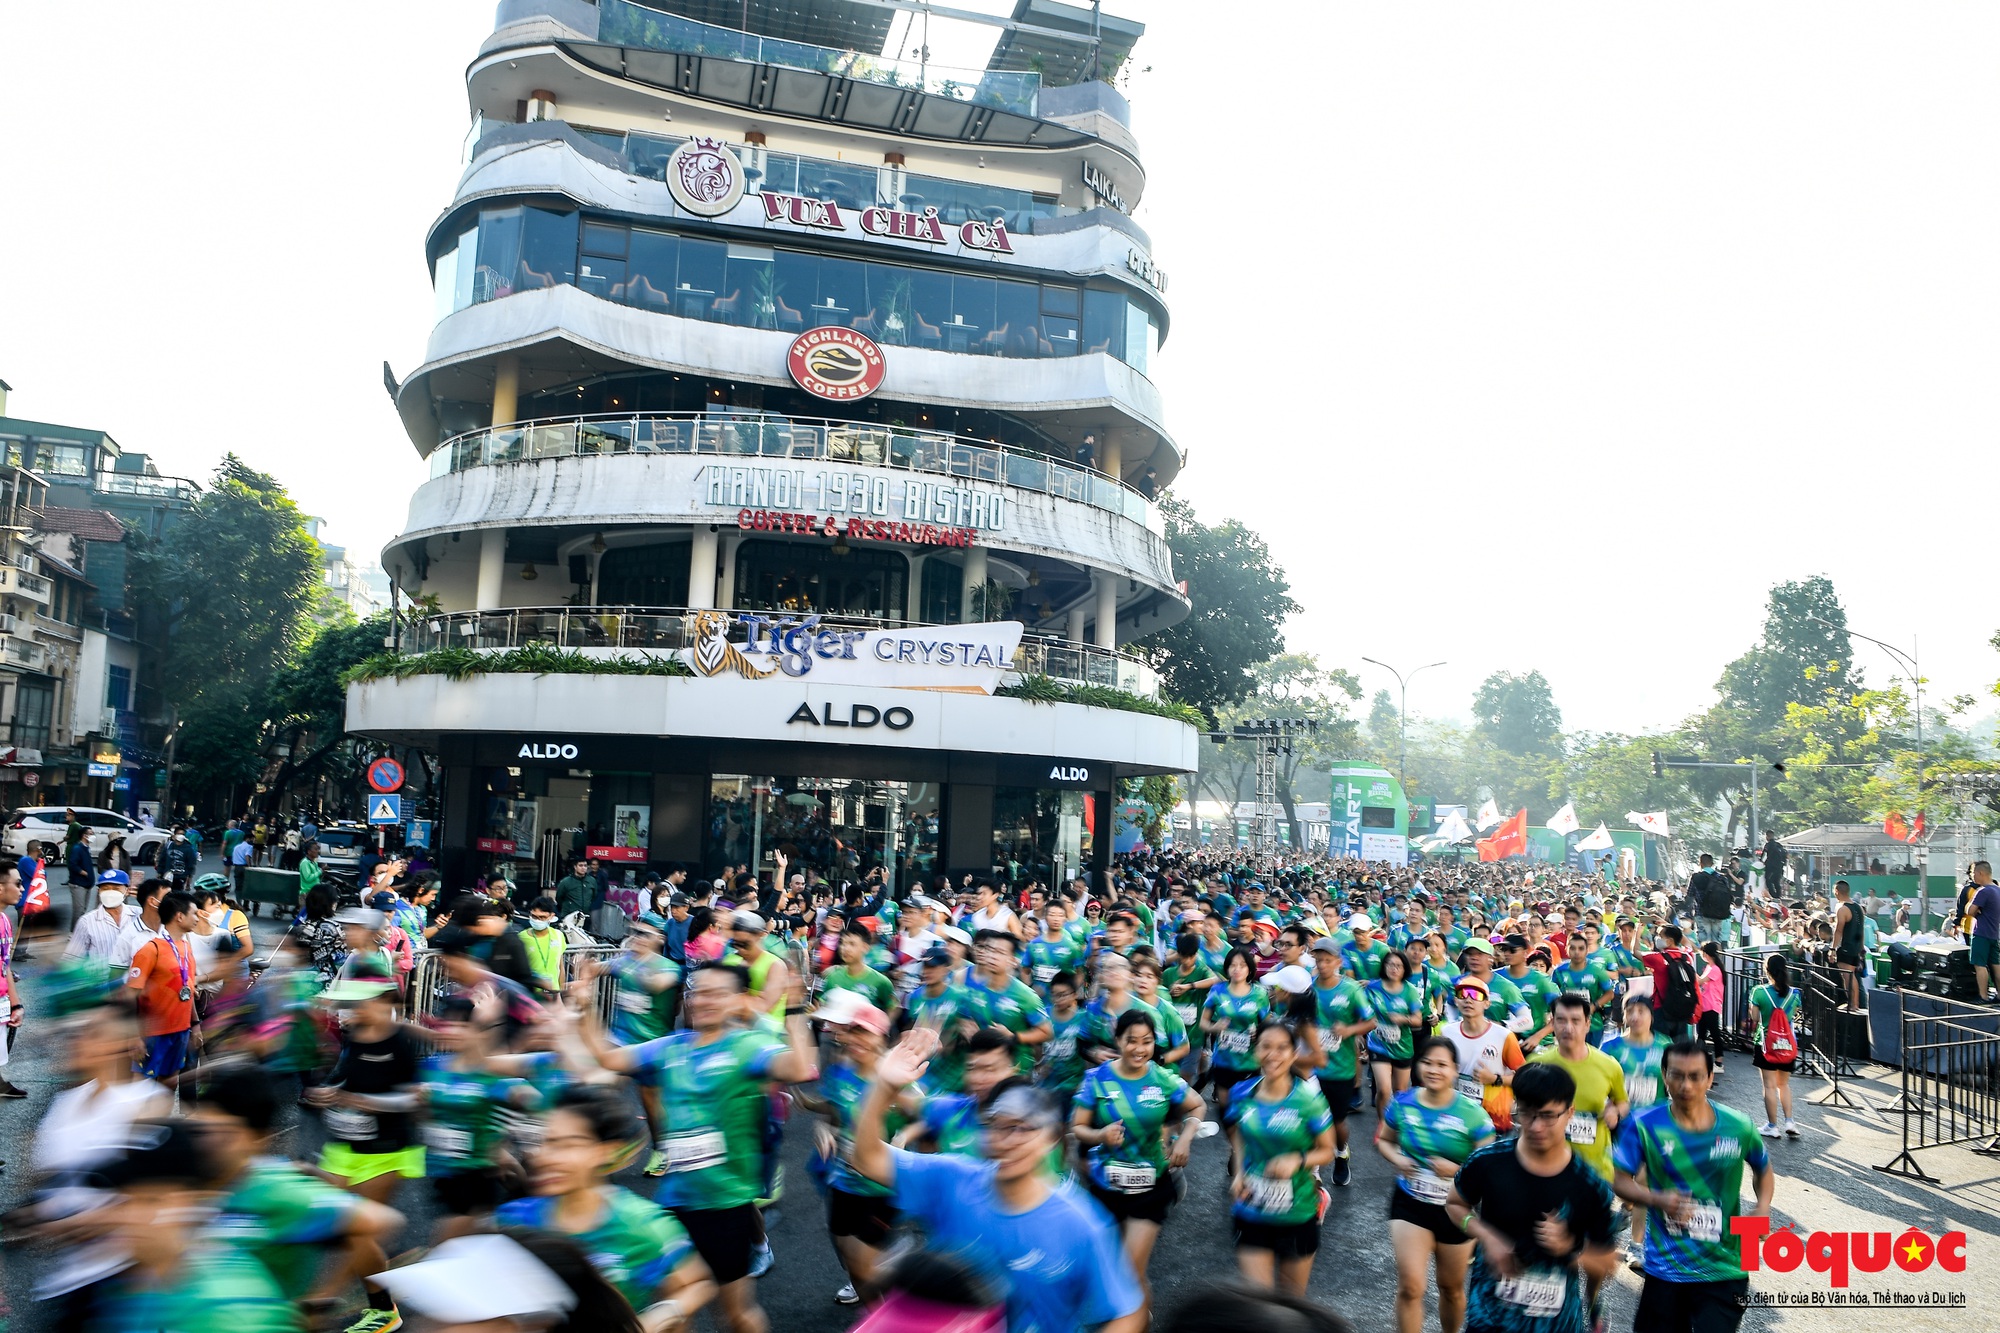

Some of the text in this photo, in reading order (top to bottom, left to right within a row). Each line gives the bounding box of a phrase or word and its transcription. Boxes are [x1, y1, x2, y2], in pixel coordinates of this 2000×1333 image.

[1082, 160, 1121, 209] LAIKA
[760, 191, 1015, 254] VUA CHẢ CÁ
[793, 331, 880, 366] HIGHLANDS
[803, 376, 870, 397] COFFEE
[705, 465, 1006, 531] HANOI 1930 BISTRO
[738, 509, 978, 548] COFFEE & RESTAURANT
[737, 614, 1015, 677] Tiger CRYSTAL
[786, 702, 915, 730] ALDO
[518, 743, 579, 760] ALDO
[1049, 766, 1089, 782] ALDO
[1345, 782, 1361, 860] START
[502, 843, 513, 851] SALE
[593, 849, 644, 858] SALE SALE
[27, 878, 48, 905] 2
